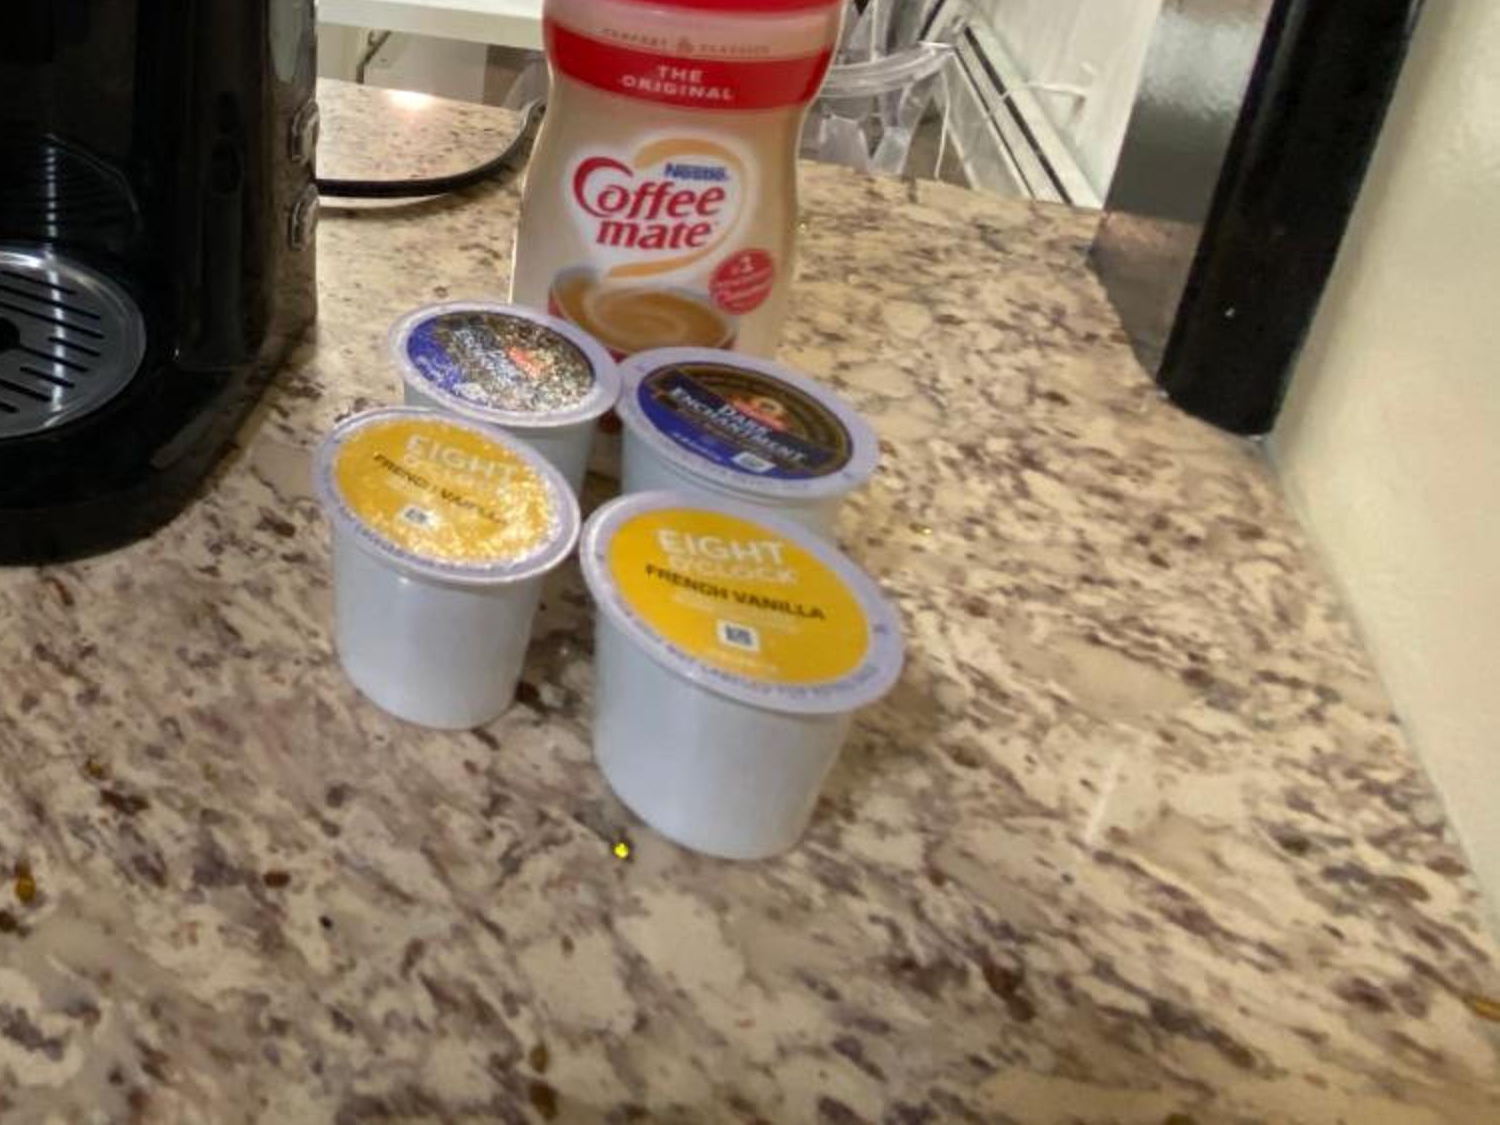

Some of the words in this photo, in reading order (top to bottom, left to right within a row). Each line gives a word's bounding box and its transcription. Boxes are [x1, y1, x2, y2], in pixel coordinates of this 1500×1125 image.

[619, 75, 734, 101] ORIGINAL
[657, 64, 703, 83] THE
[573, 156, 726, 220] Coffee
[596, 219, 712, 249] mate
[657, 528, 784, 565] EIGHT
[645, 563, 729, 599] FRENCH
[732, 589, 826, 620] VANILLA
